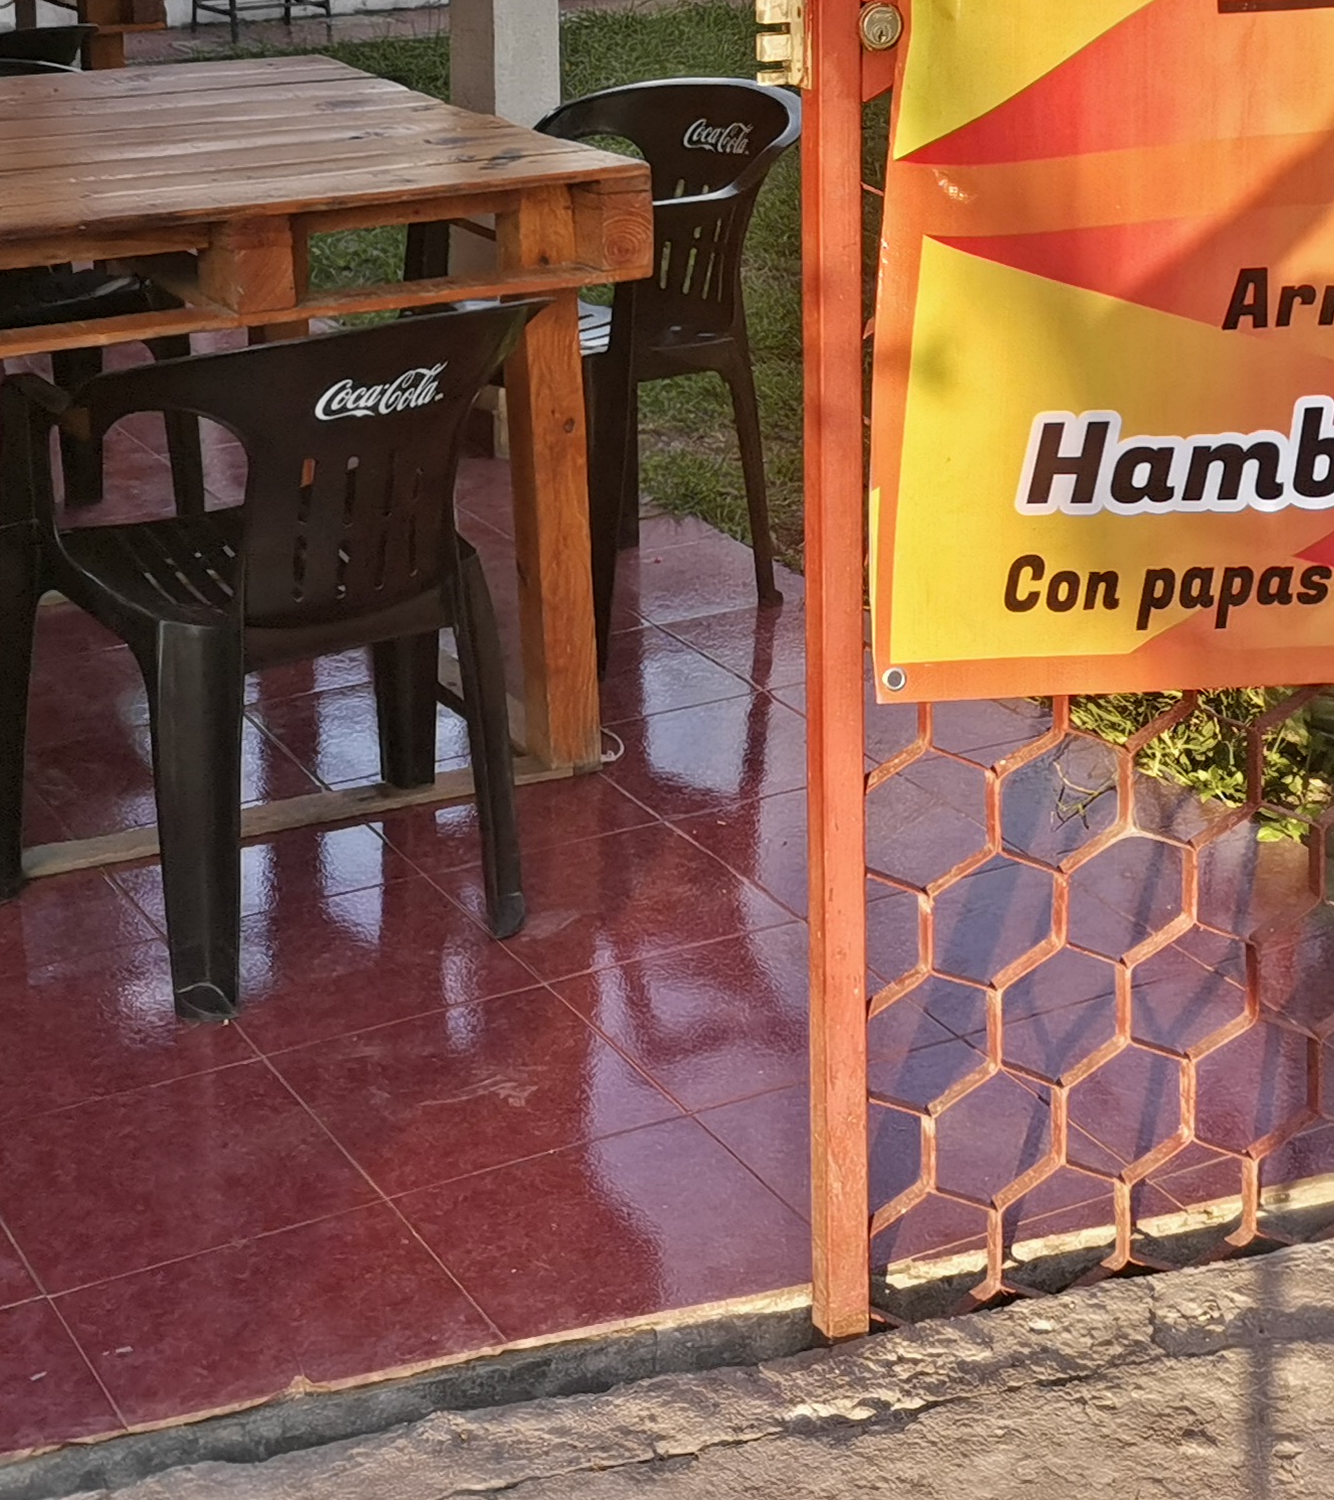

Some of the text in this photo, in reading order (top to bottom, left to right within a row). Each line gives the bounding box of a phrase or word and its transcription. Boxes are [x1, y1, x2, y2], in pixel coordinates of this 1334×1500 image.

[314, 360, 448, 420] Coca-Cola
[1004, 554, 1120, 613] Con
[1136, 560, 1329, 630] papas
